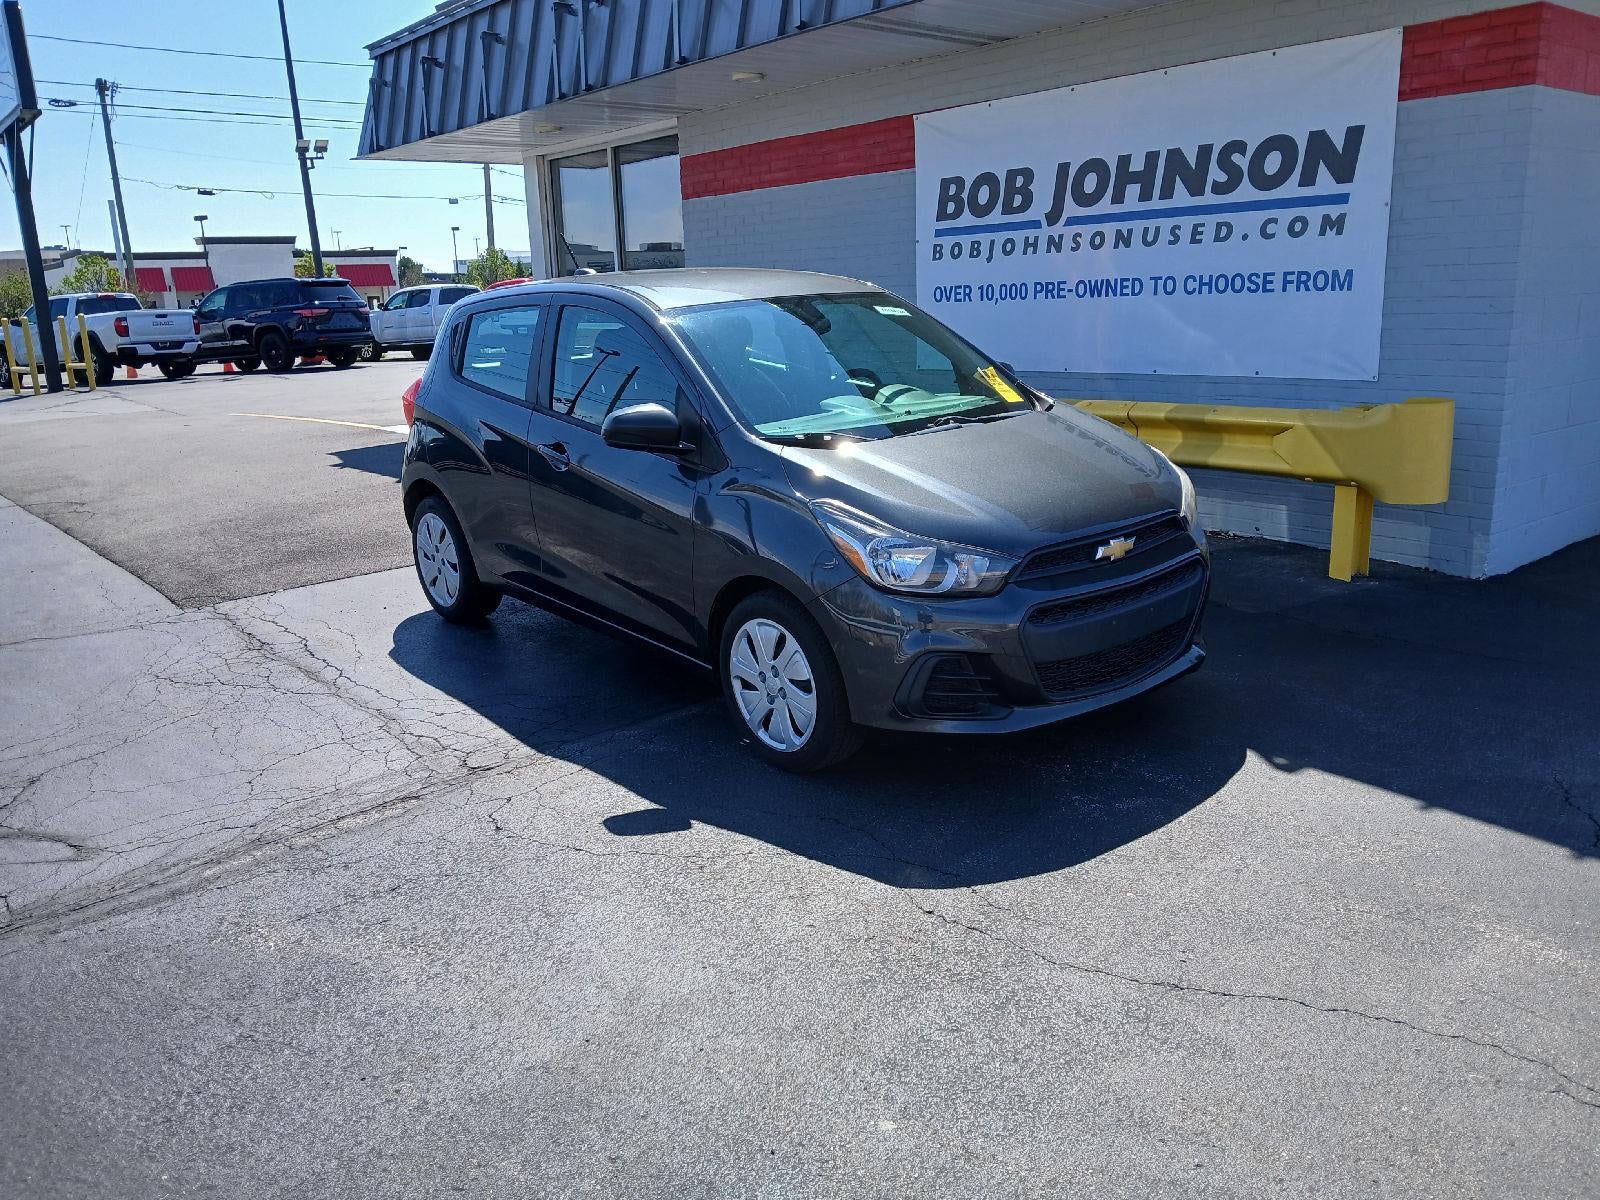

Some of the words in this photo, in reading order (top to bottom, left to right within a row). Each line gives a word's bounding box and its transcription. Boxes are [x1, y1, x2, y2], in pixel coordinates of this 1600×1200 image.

[935, 166, 1035, 223] BOB
[1044, 124, 1366, 228] JOHNSON
[931, 212, 1348, 263] BOBJOHNSONUSED.COM
[933, 283, 973, 303] OVER
[977, 281, 1029, 306] 10,000
[1033, 277, 1144, 300] PRE-OWNED
[1149, 275, 1177, 297] TO
[1183, 271, 1276, 296] CHOOSE
[1281, 268, 1354, 293] FROM
